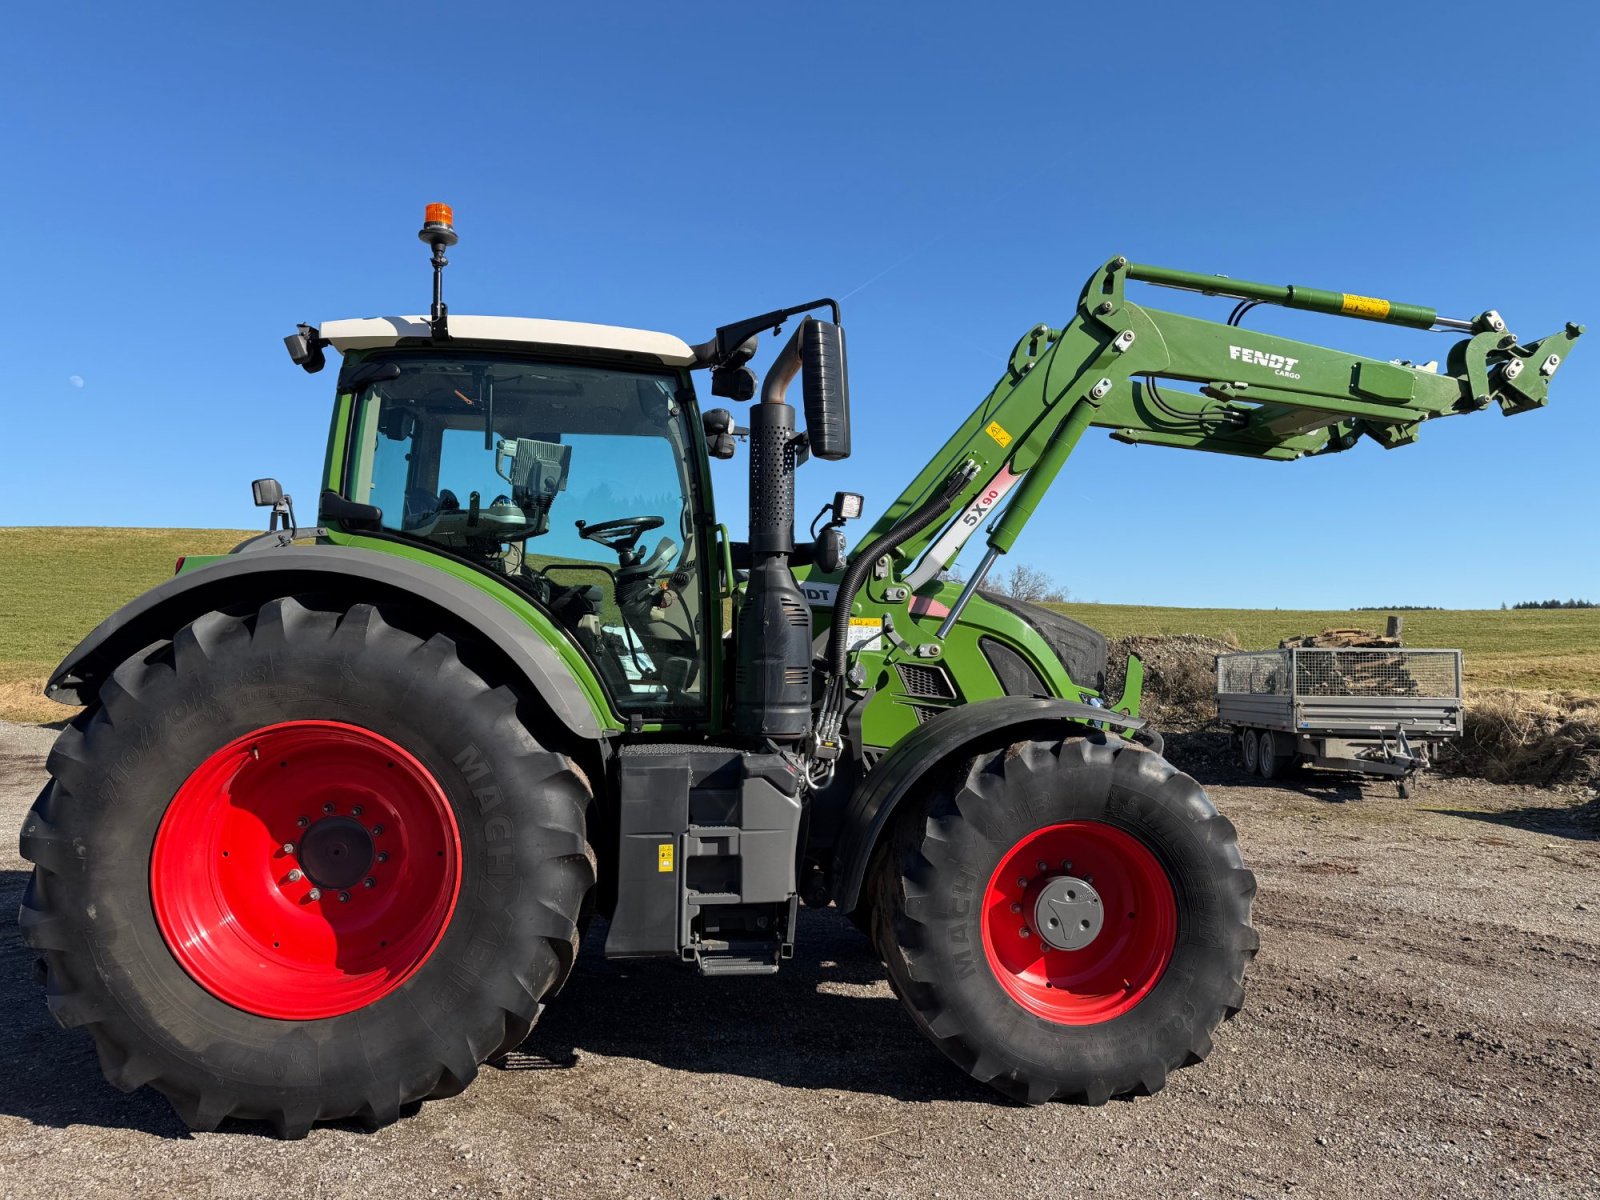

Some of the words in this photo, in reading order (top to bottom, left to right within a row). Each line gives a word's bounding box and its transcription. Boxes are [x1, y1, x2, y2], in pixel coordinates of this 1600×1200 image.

[1229, 344, 1299, 371] FENDT
[1275, 369, 1301, 380] CARGO
[452, 741, 516, 876] MACH
[947, 865, 979, 980] MACH
